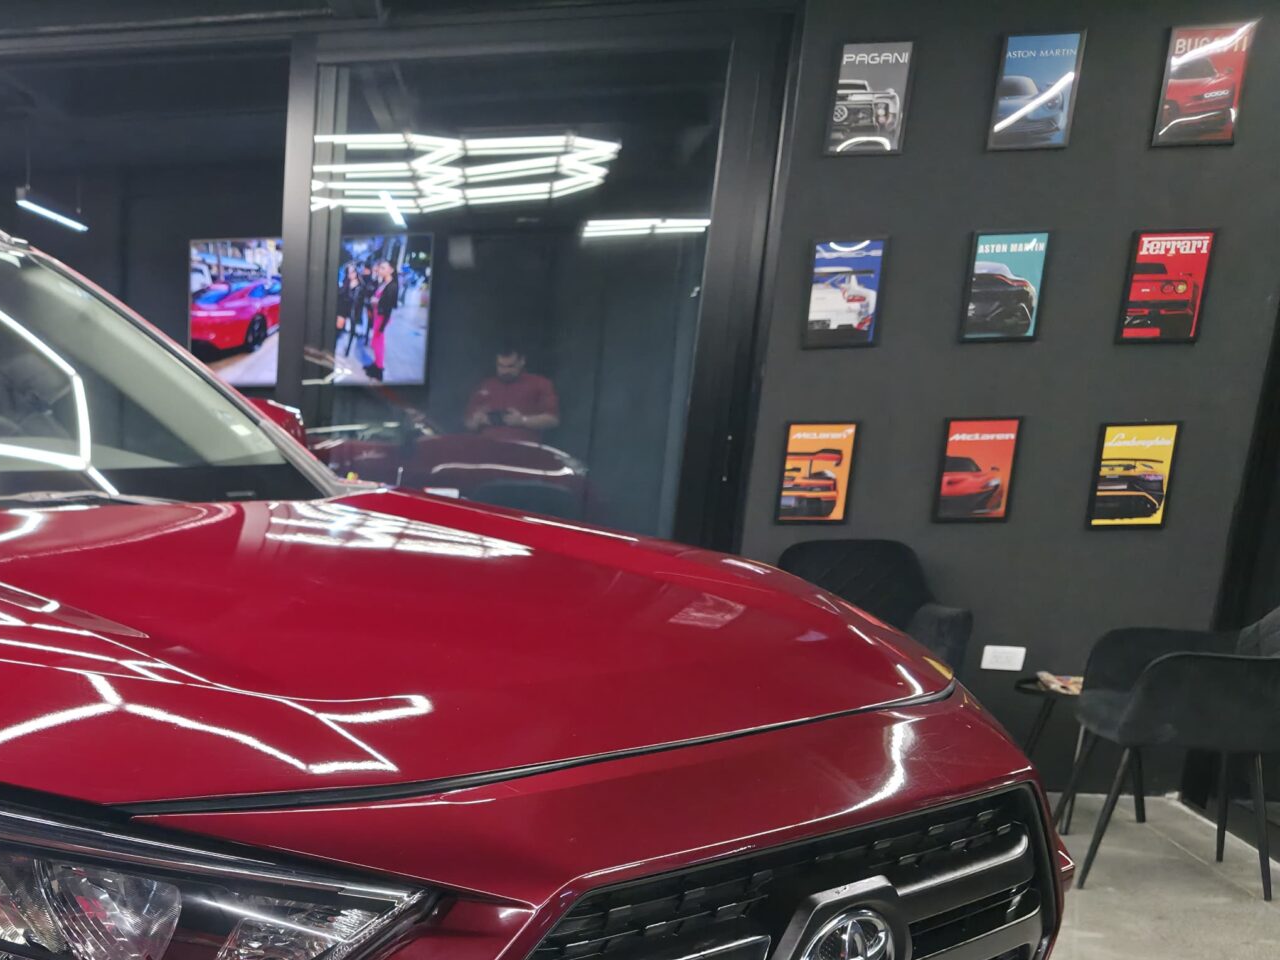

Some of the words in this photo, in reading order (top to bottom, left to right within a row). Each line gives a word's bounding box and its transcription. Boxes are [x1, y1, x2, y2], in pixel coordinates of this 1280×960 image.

[1174, 35, 1248, 54] BUGTI
[843, 52, 909, 65] PAGANI
[1006, 50, 1037, 59] ASTON
[1040, 47, 1077, 57] MARTIN
[978, 244, 1008, 254] ASTON
[1139, 235, 1210, 257] Ferrari
